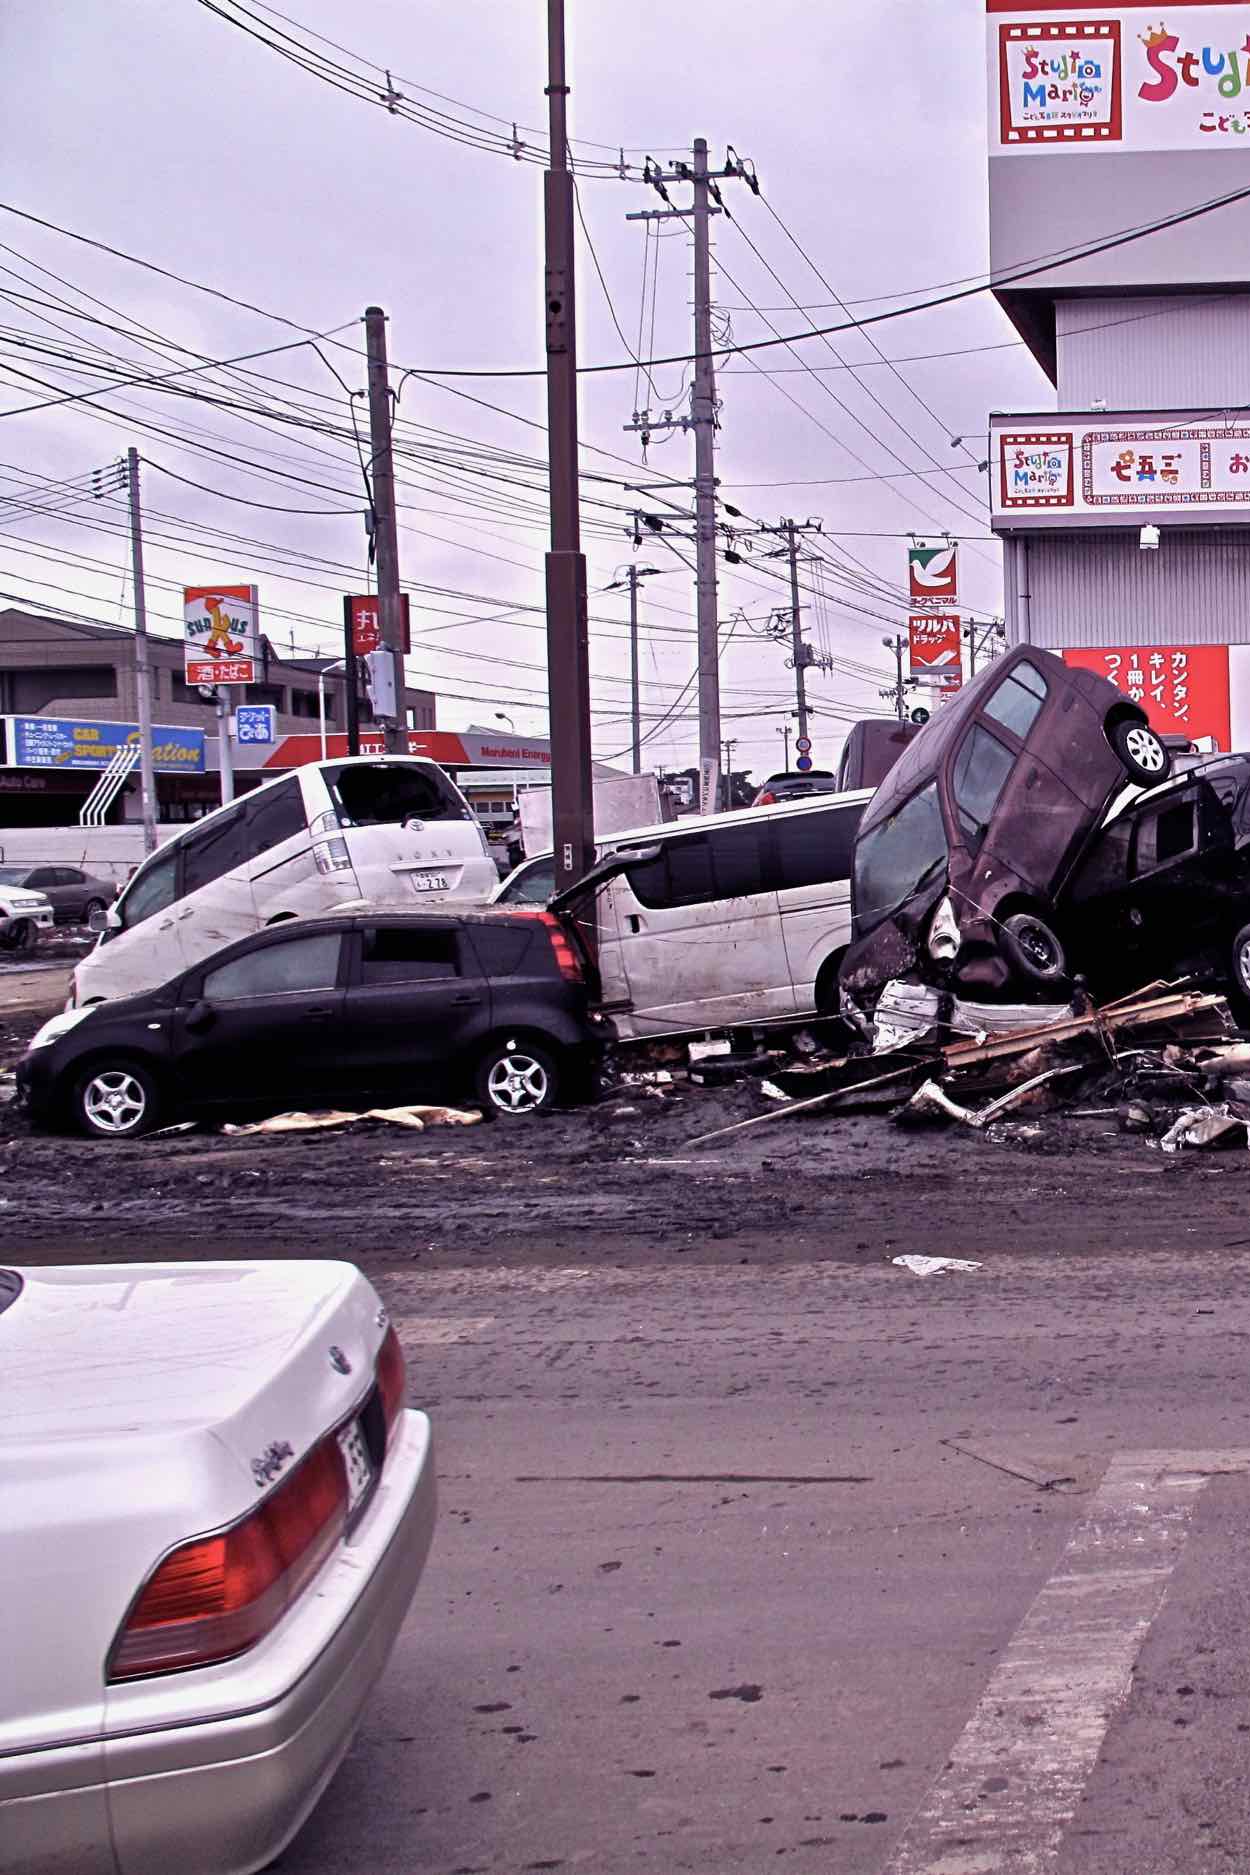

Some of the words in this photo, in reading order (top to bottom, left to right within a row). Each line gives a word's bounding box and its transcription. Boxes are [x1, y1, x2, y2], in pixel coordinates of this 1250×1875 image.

[1022, 48, 1101, 80] Studio
[1022, 81, 1101, 107] Mario
[1111, 453, 1182, 483] 七五三
[913, 619, 956, 633] ツルハ
[1149, 653, 1166, 708] キレイ、
[1172, 652, 1188, 721] カンタン、
